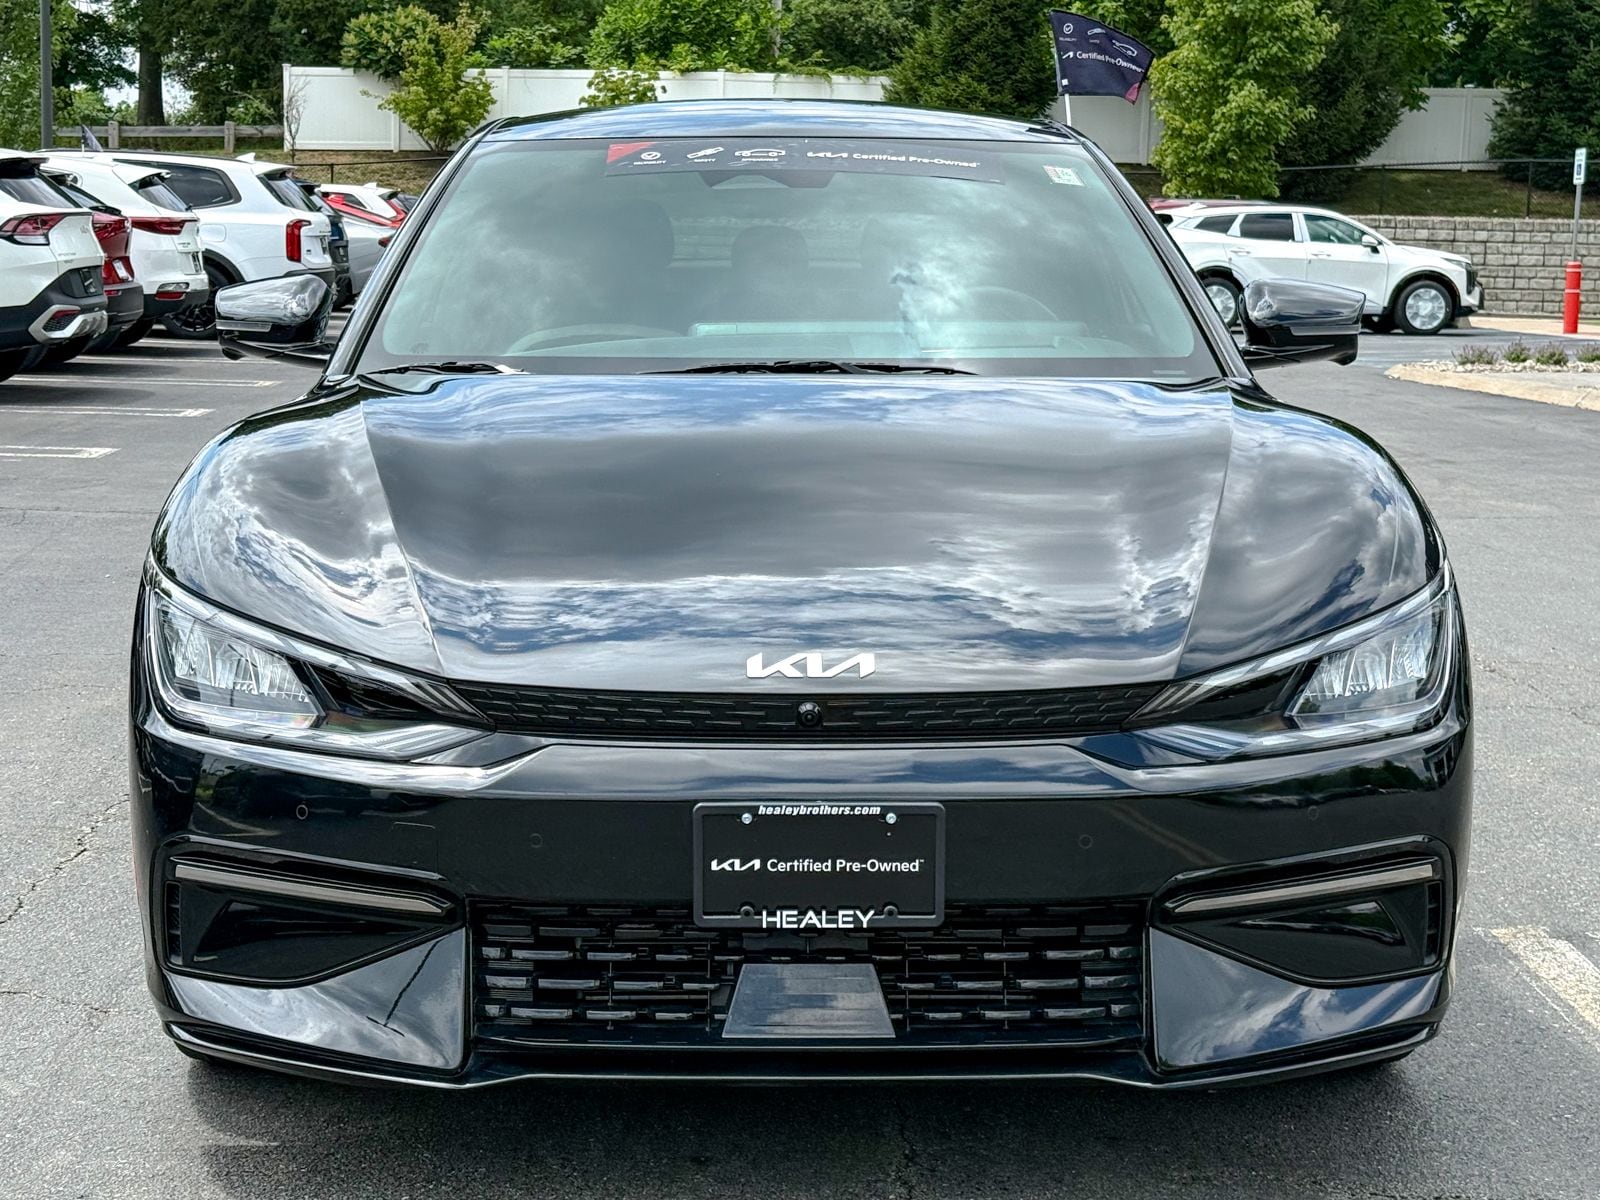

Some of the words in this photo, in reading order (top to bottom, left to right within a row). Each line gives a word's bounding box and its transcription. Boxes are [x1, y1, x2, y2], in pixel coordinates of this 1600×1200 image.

[852, 152, 906, 162] Certified
[908, 156, 978, 168] Pre-Owned
[746, 652, 876, 679] KIA
[758, 805, 881, 816] healeybrothers.com
[710, 858, 761, 872] KIA
[766, 859, 832, 873] Certified
[761, 910, 875, 929] HEALEY
